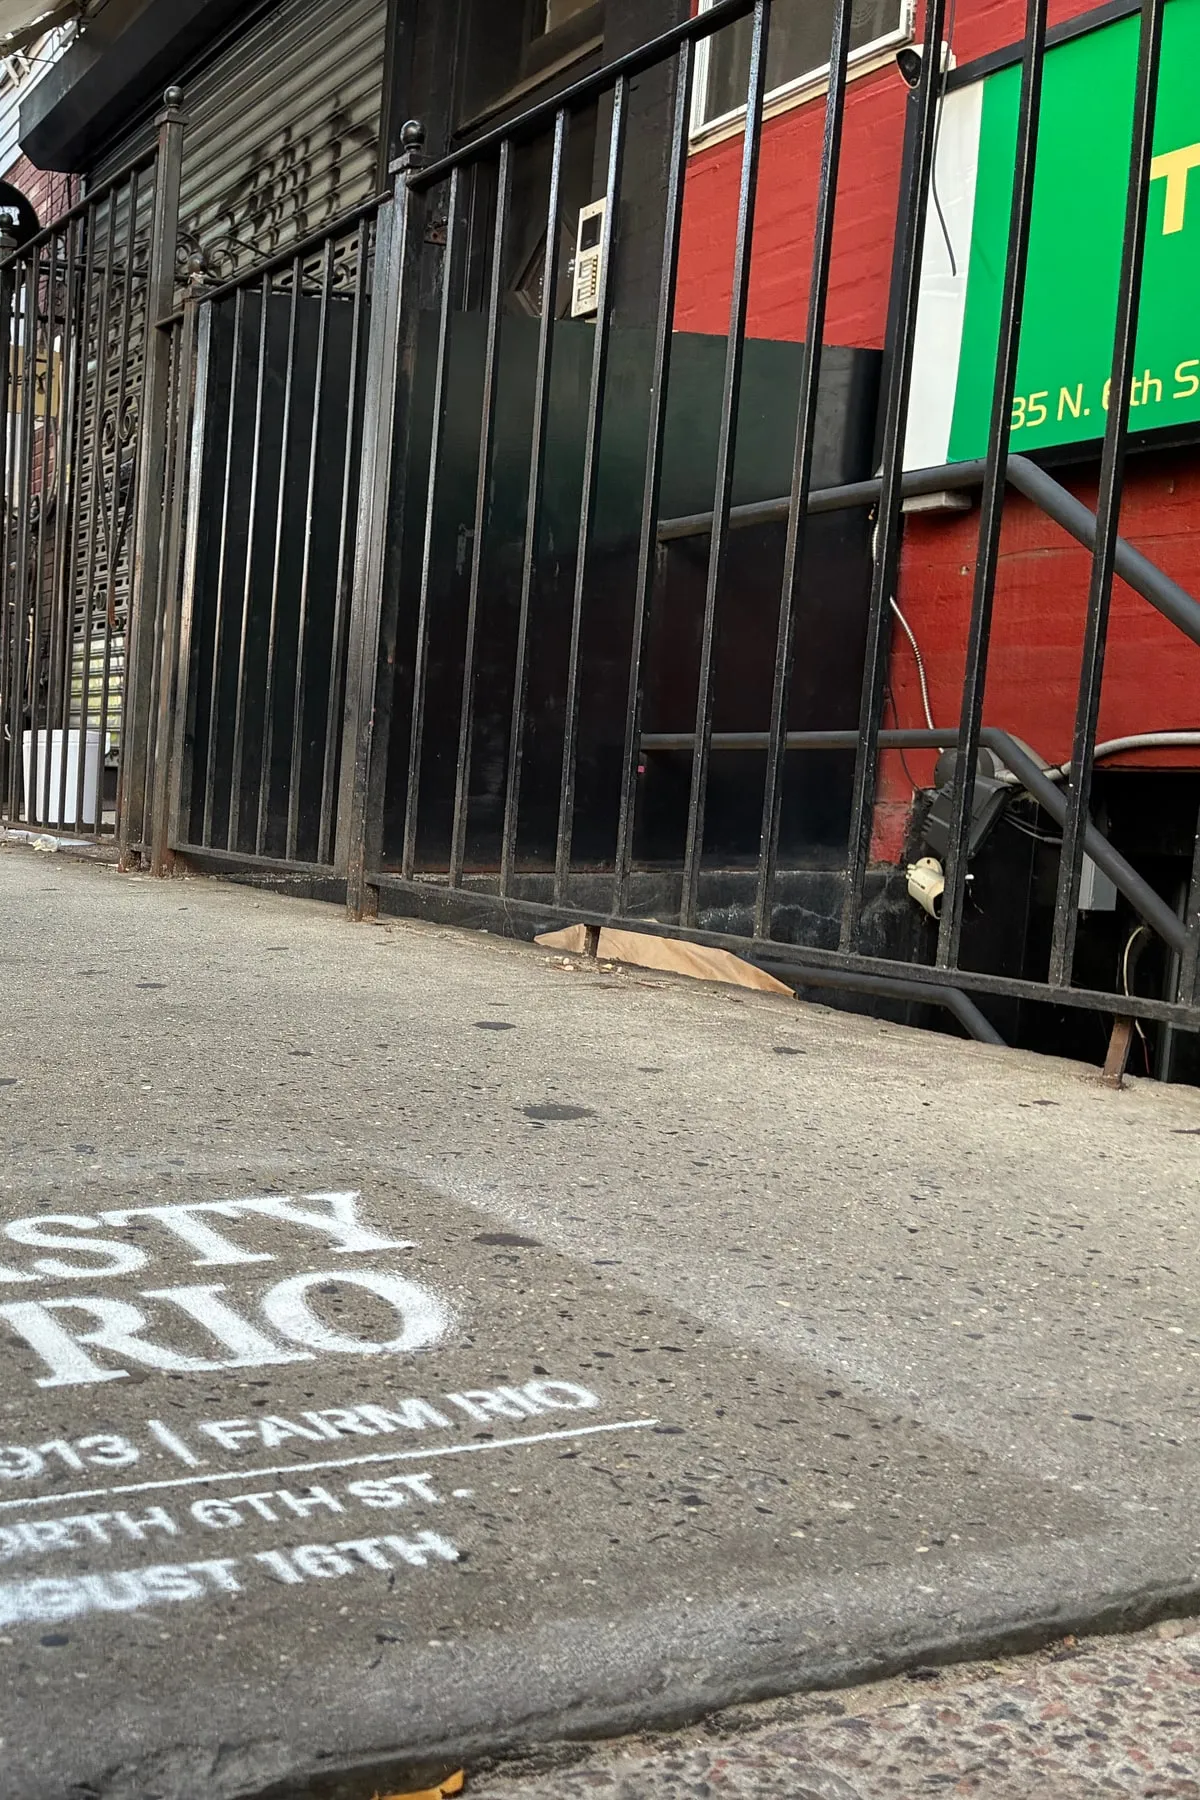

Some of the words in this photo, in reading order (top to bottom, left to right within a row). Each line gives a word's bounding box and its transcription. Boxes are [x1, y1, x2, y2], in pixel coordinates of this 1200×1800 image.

[1056, 383, 1090, 421] N.
[200, 1398, 452, 1451] FARM
[447, 1379, 600, 1422] RIO
[192, 1489, 344, 1530] 6TH
[347, 1473, 474, 1509] ST.
[253, 1529, 461, 1585] 16TH
